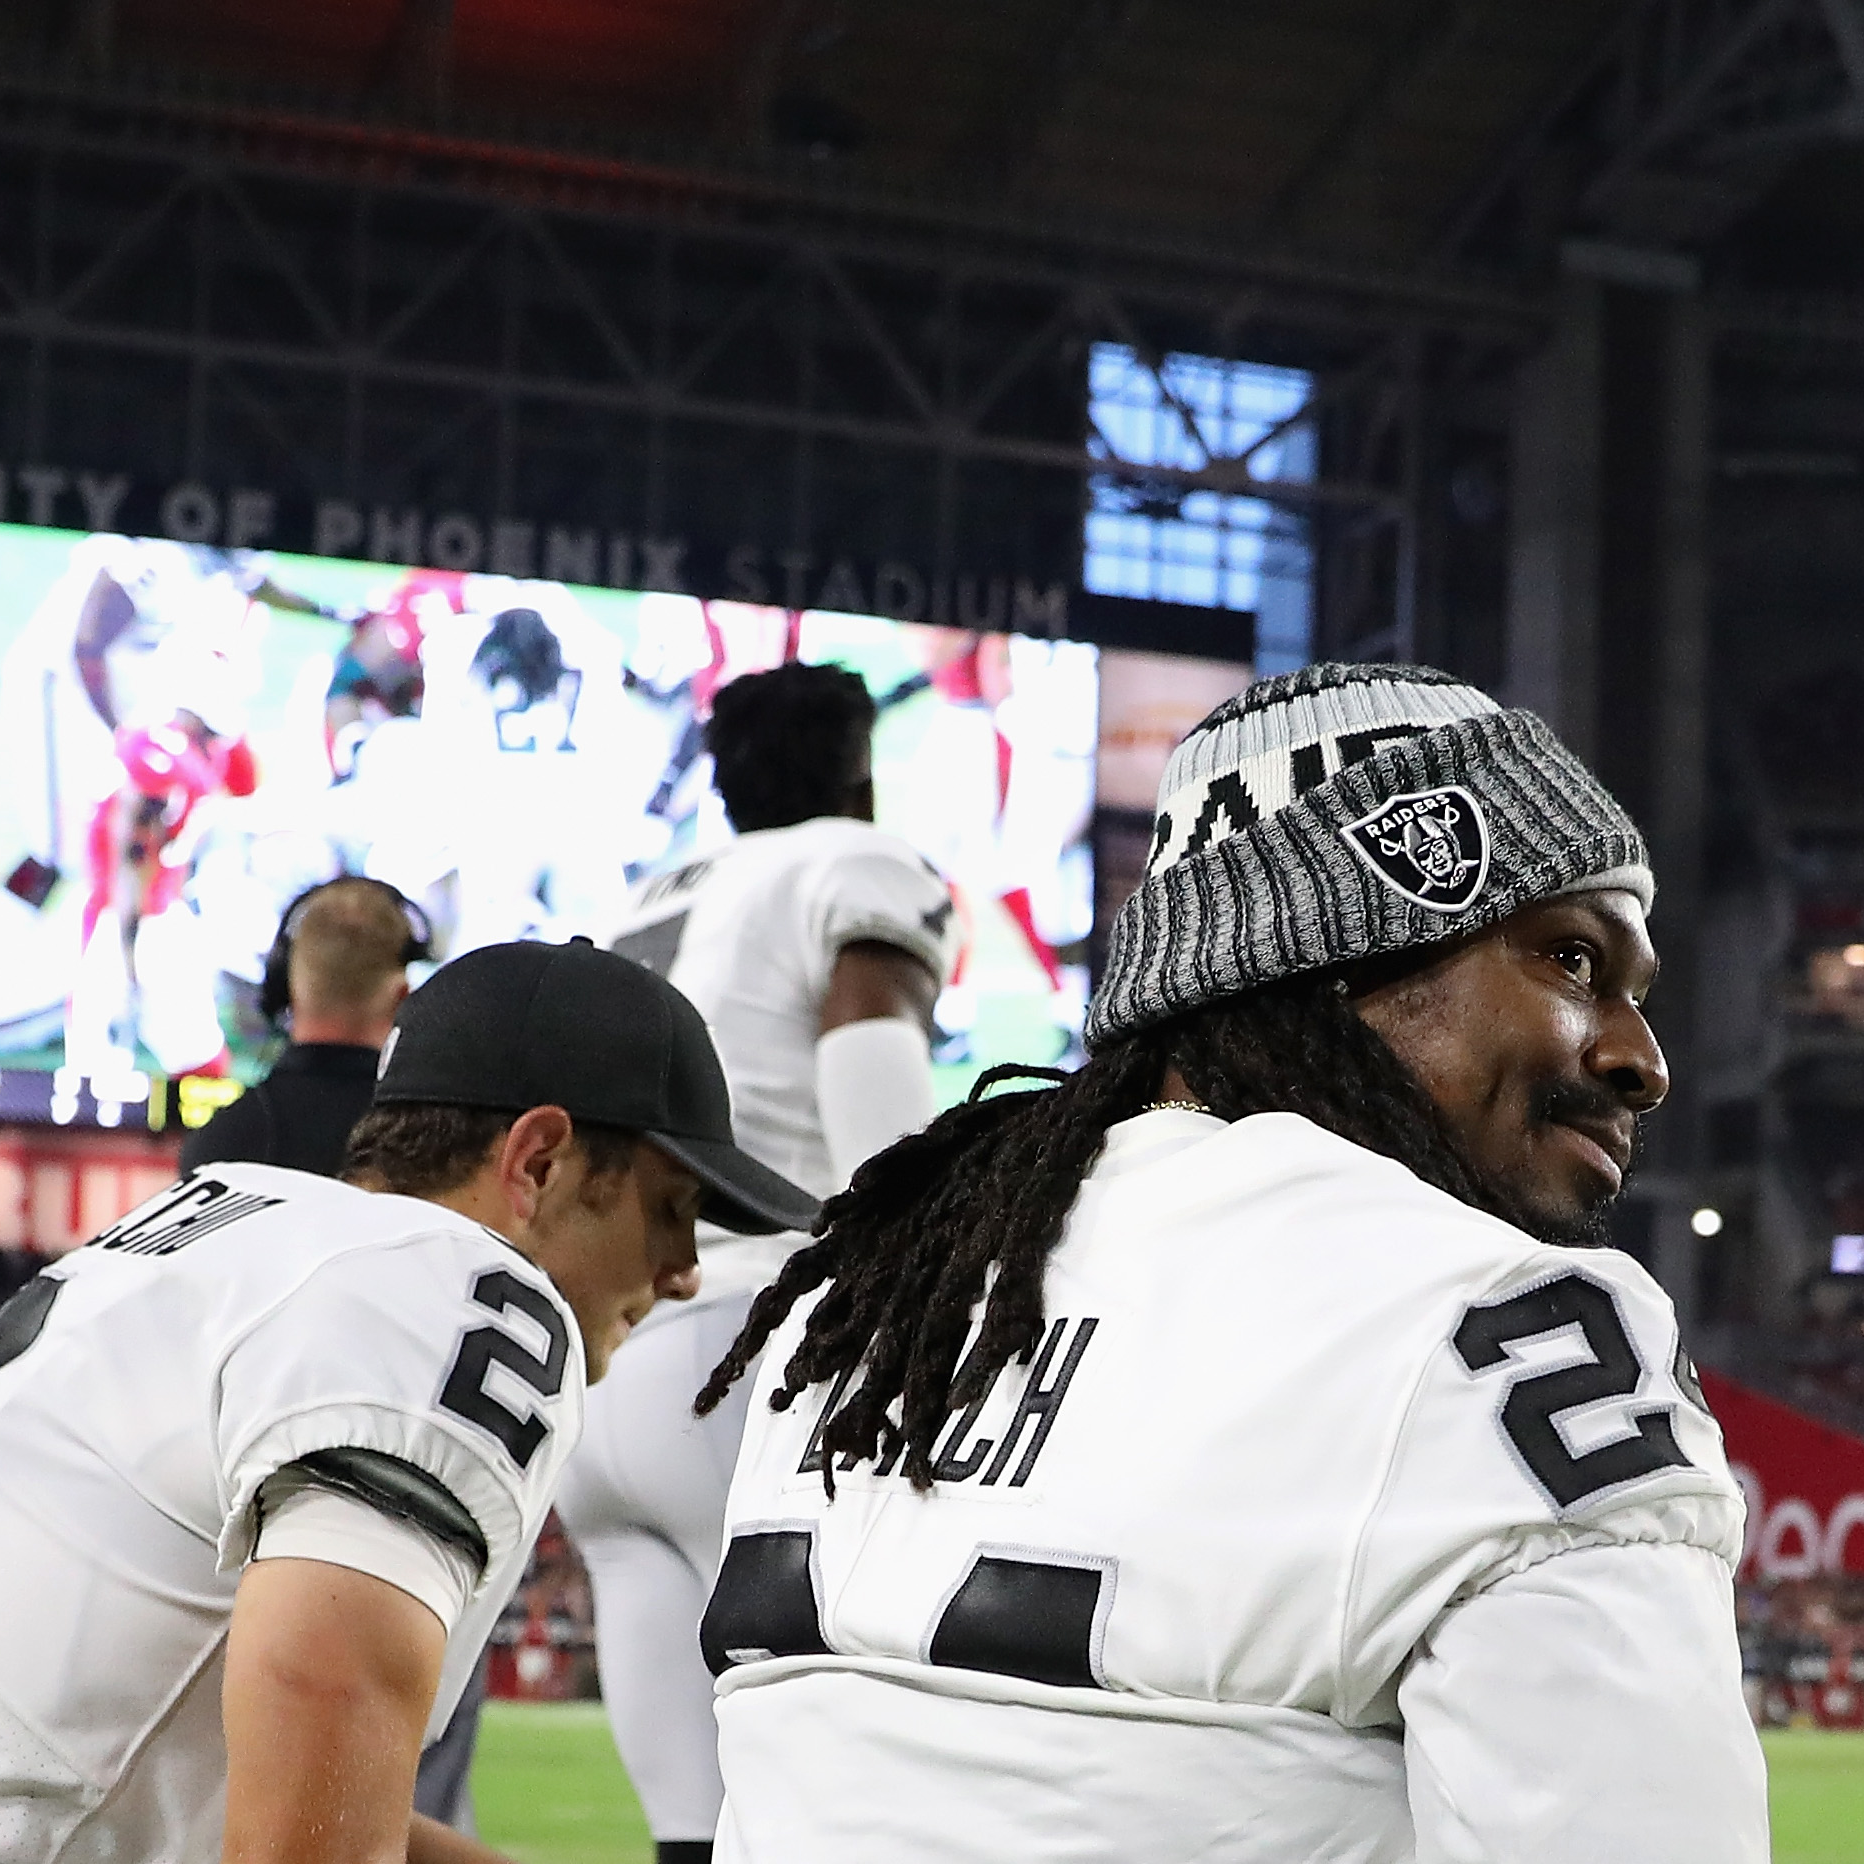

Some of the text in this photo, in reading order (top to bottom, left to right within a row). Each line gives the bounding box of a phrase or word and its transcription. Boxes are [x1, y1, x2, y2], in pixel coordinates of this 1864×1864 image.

[162, 485, 276, 547] OF
[315, 501, 688, 589] PHOENIX
[726, 551, 1070, 638] STADIUM
[1365, 793, 1450, 838] RAIDERS
[437, 1266, 571, 1473] 2
[1454, 1268, 1711, 1514] 2
